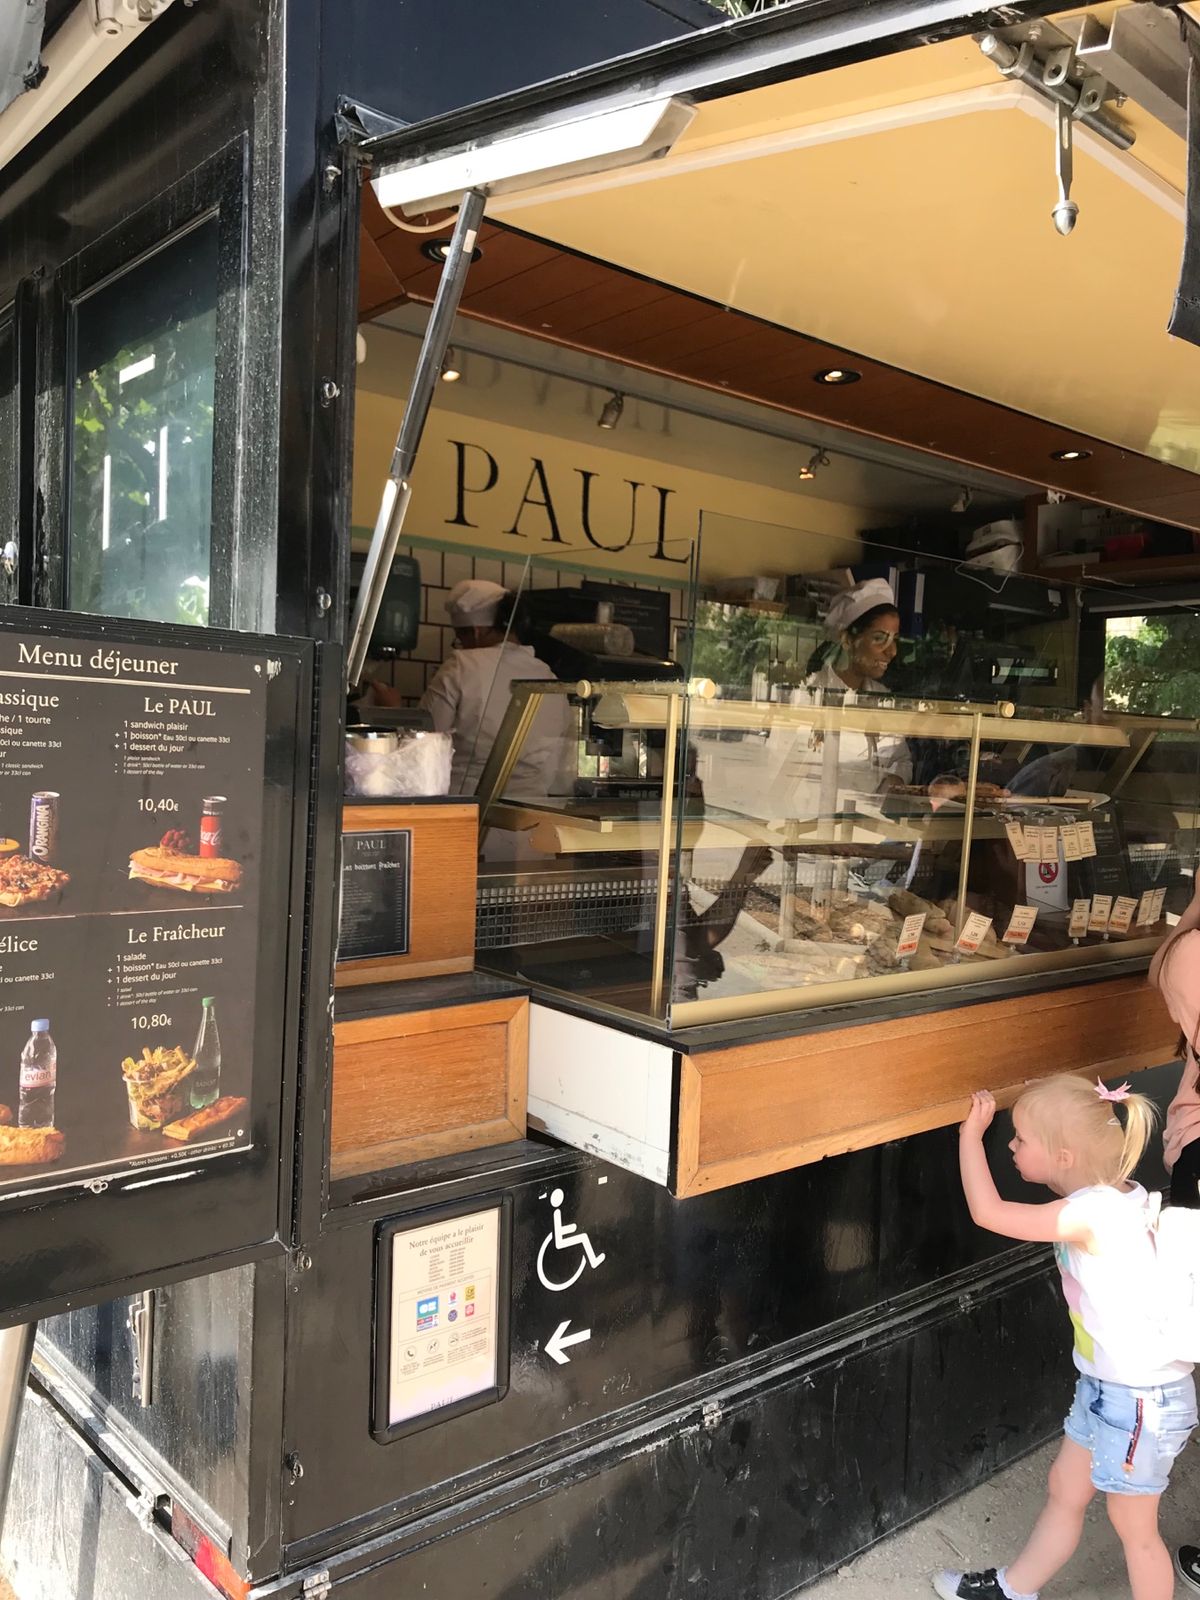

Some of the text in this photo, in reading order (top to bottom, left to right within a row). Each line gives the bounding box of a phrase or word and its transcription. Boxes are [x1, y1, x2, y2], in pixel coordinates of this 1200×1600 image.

[444, 439, 690, 564] PAUL
[18, 643, 179, 677] Menu déjeuner
[144, 697, 216, 717] Le PAUL
[18, 714, 22, 723] 1
[25, 715, 52, 724] tourte
[123, 720, 189, 732] 1 sandwich plaisir
[123, 731, 128, 739] 1
[48, 740, 62, 748] 33cl
[123, 742, 128, 750] 1
[129, 742, 157, 752] dessert
[157, 743, 168, 752] du
[169, 743, 185, 753] jour
[137, 798, 179, 813] 10,40€
[32, 804, 50, 856] ORANGINA
[357, 839, 386, 850] PAUL
[128, 923, 226, 944] Le Fraîcheur
[116, 952, 147, 962] 1 salade
[116, 976, 120, 984] 1
[122, 974, 149, 984] dessert
[150, 972, 161, 981] du
[161, 971, 177, 982] jour
[131, 1013, 172, 1030] 10,80€
[25, 1070, 52, 1081] evian
[409, 1239, 429, 1250] Notre
[429, 1232, 452, 1245] équipe
[464, 1223, 485, 1236] plaisir
[419, 1237, 474, 1257] de vous accueillir
